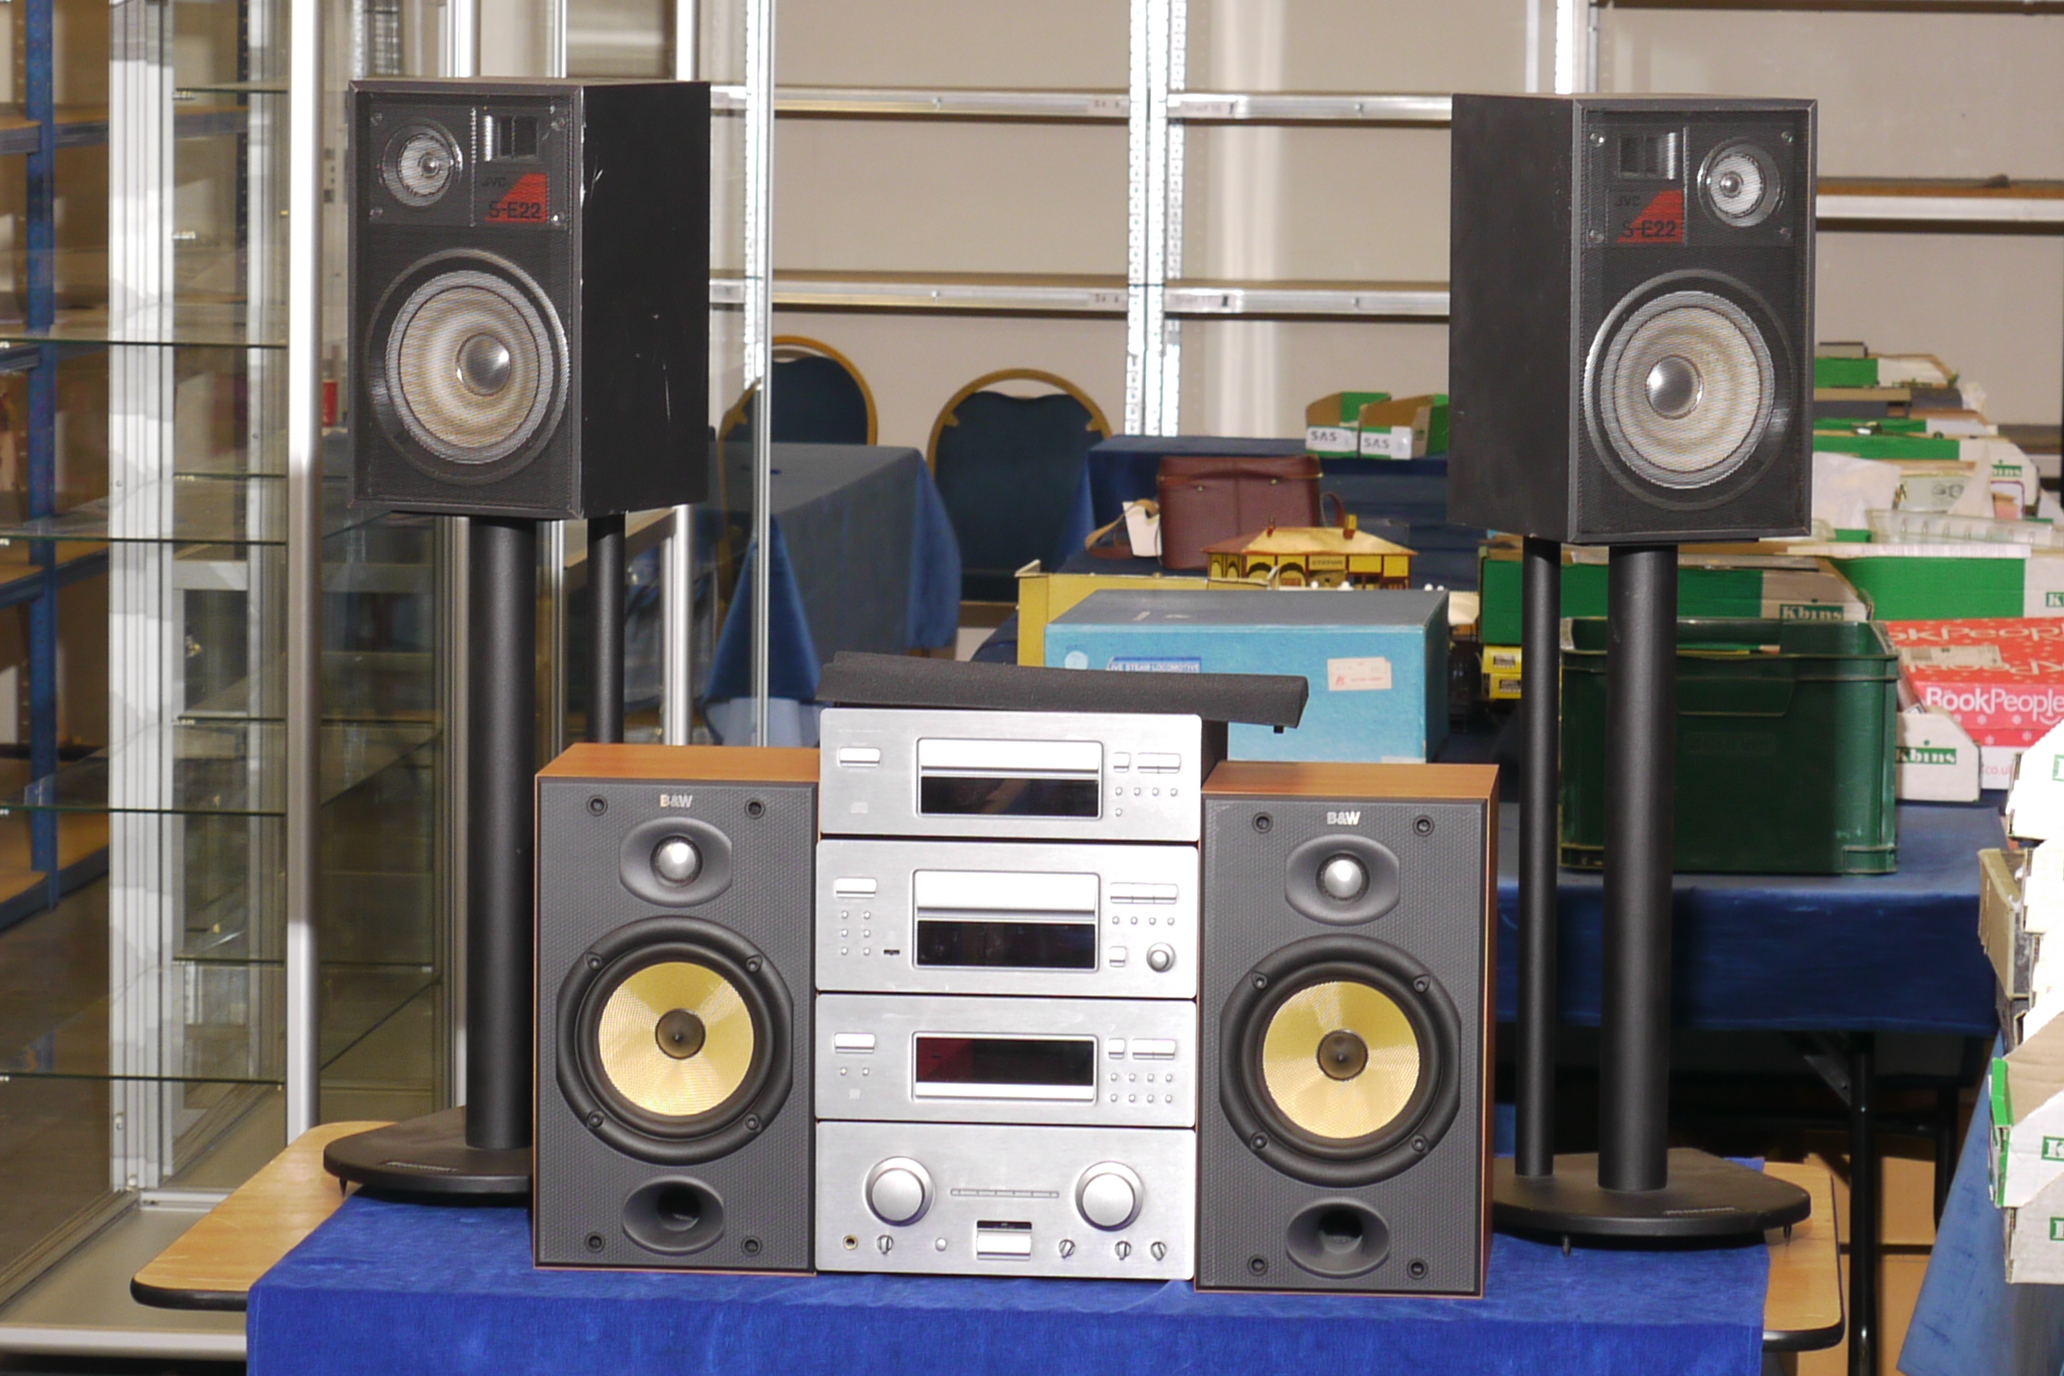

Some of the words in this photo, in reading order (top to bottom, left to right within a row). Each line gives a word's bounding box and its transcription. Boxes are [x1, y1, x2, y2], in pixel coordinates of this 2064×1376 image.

[488, 201, 543, 219] S-E22
[1622, 220, 1677, 238] S-E22
[1310, 430, 1338, 442] SAS
[1363, 438, 1390, 450] SAS
[1781, 604, 1843, 620] Kbins
[660, 794, 693, 808] B&W
[1326, 811, 1360, 825] B&W
